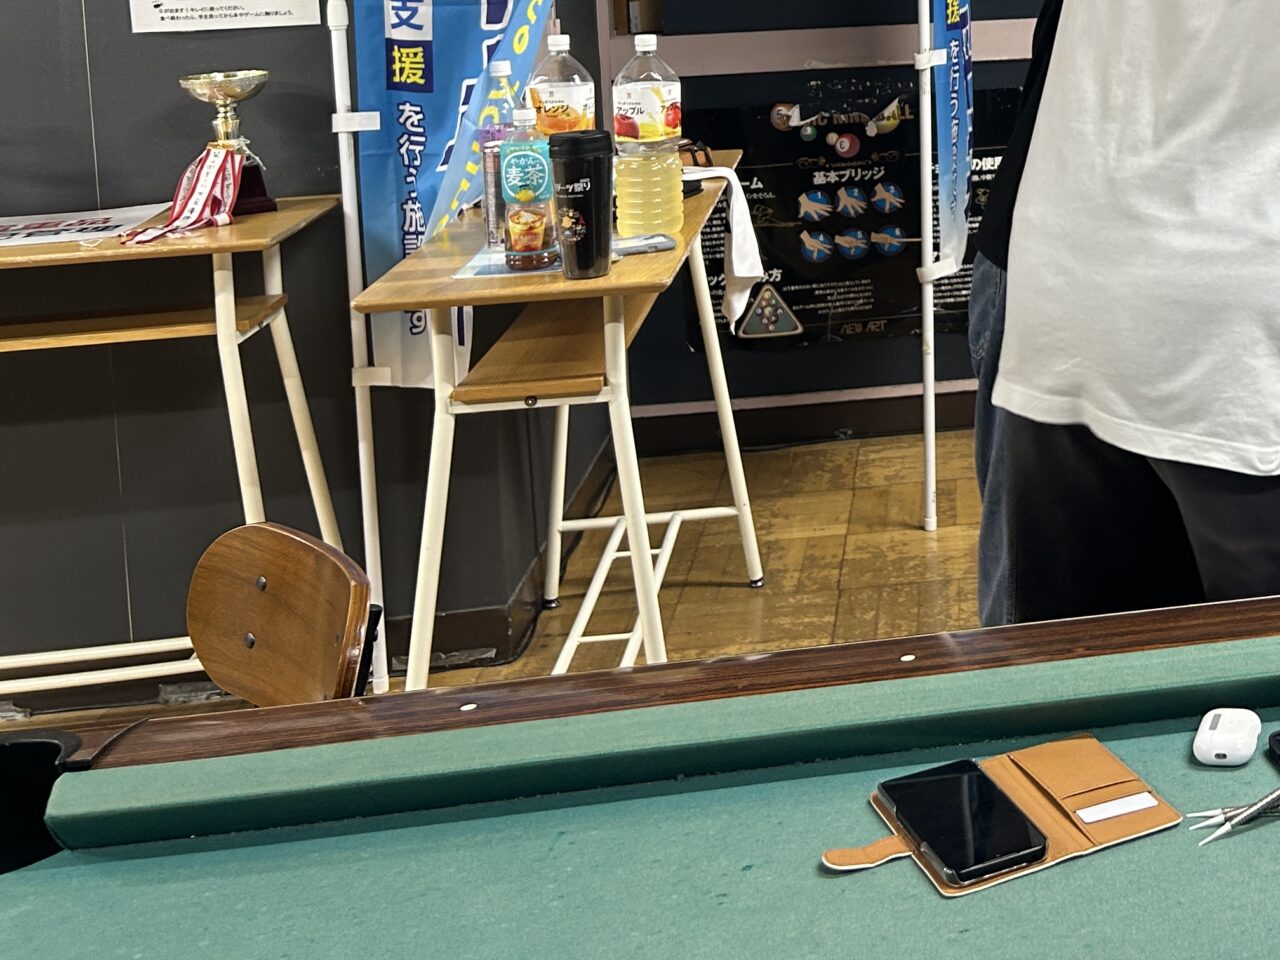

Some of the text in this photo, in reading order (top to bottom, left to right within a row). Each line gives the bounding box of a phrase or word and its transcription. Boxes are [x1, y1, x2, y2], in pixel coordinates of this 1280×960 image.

[535, 105, 570, 113] オレンジ
[616, 106, 645, 115] アップル
[506, 164, 546, 187] 麦茶
[812, 167, 885, 185] 基本ブリッジ
[741, 177, 764, 189] ーム
